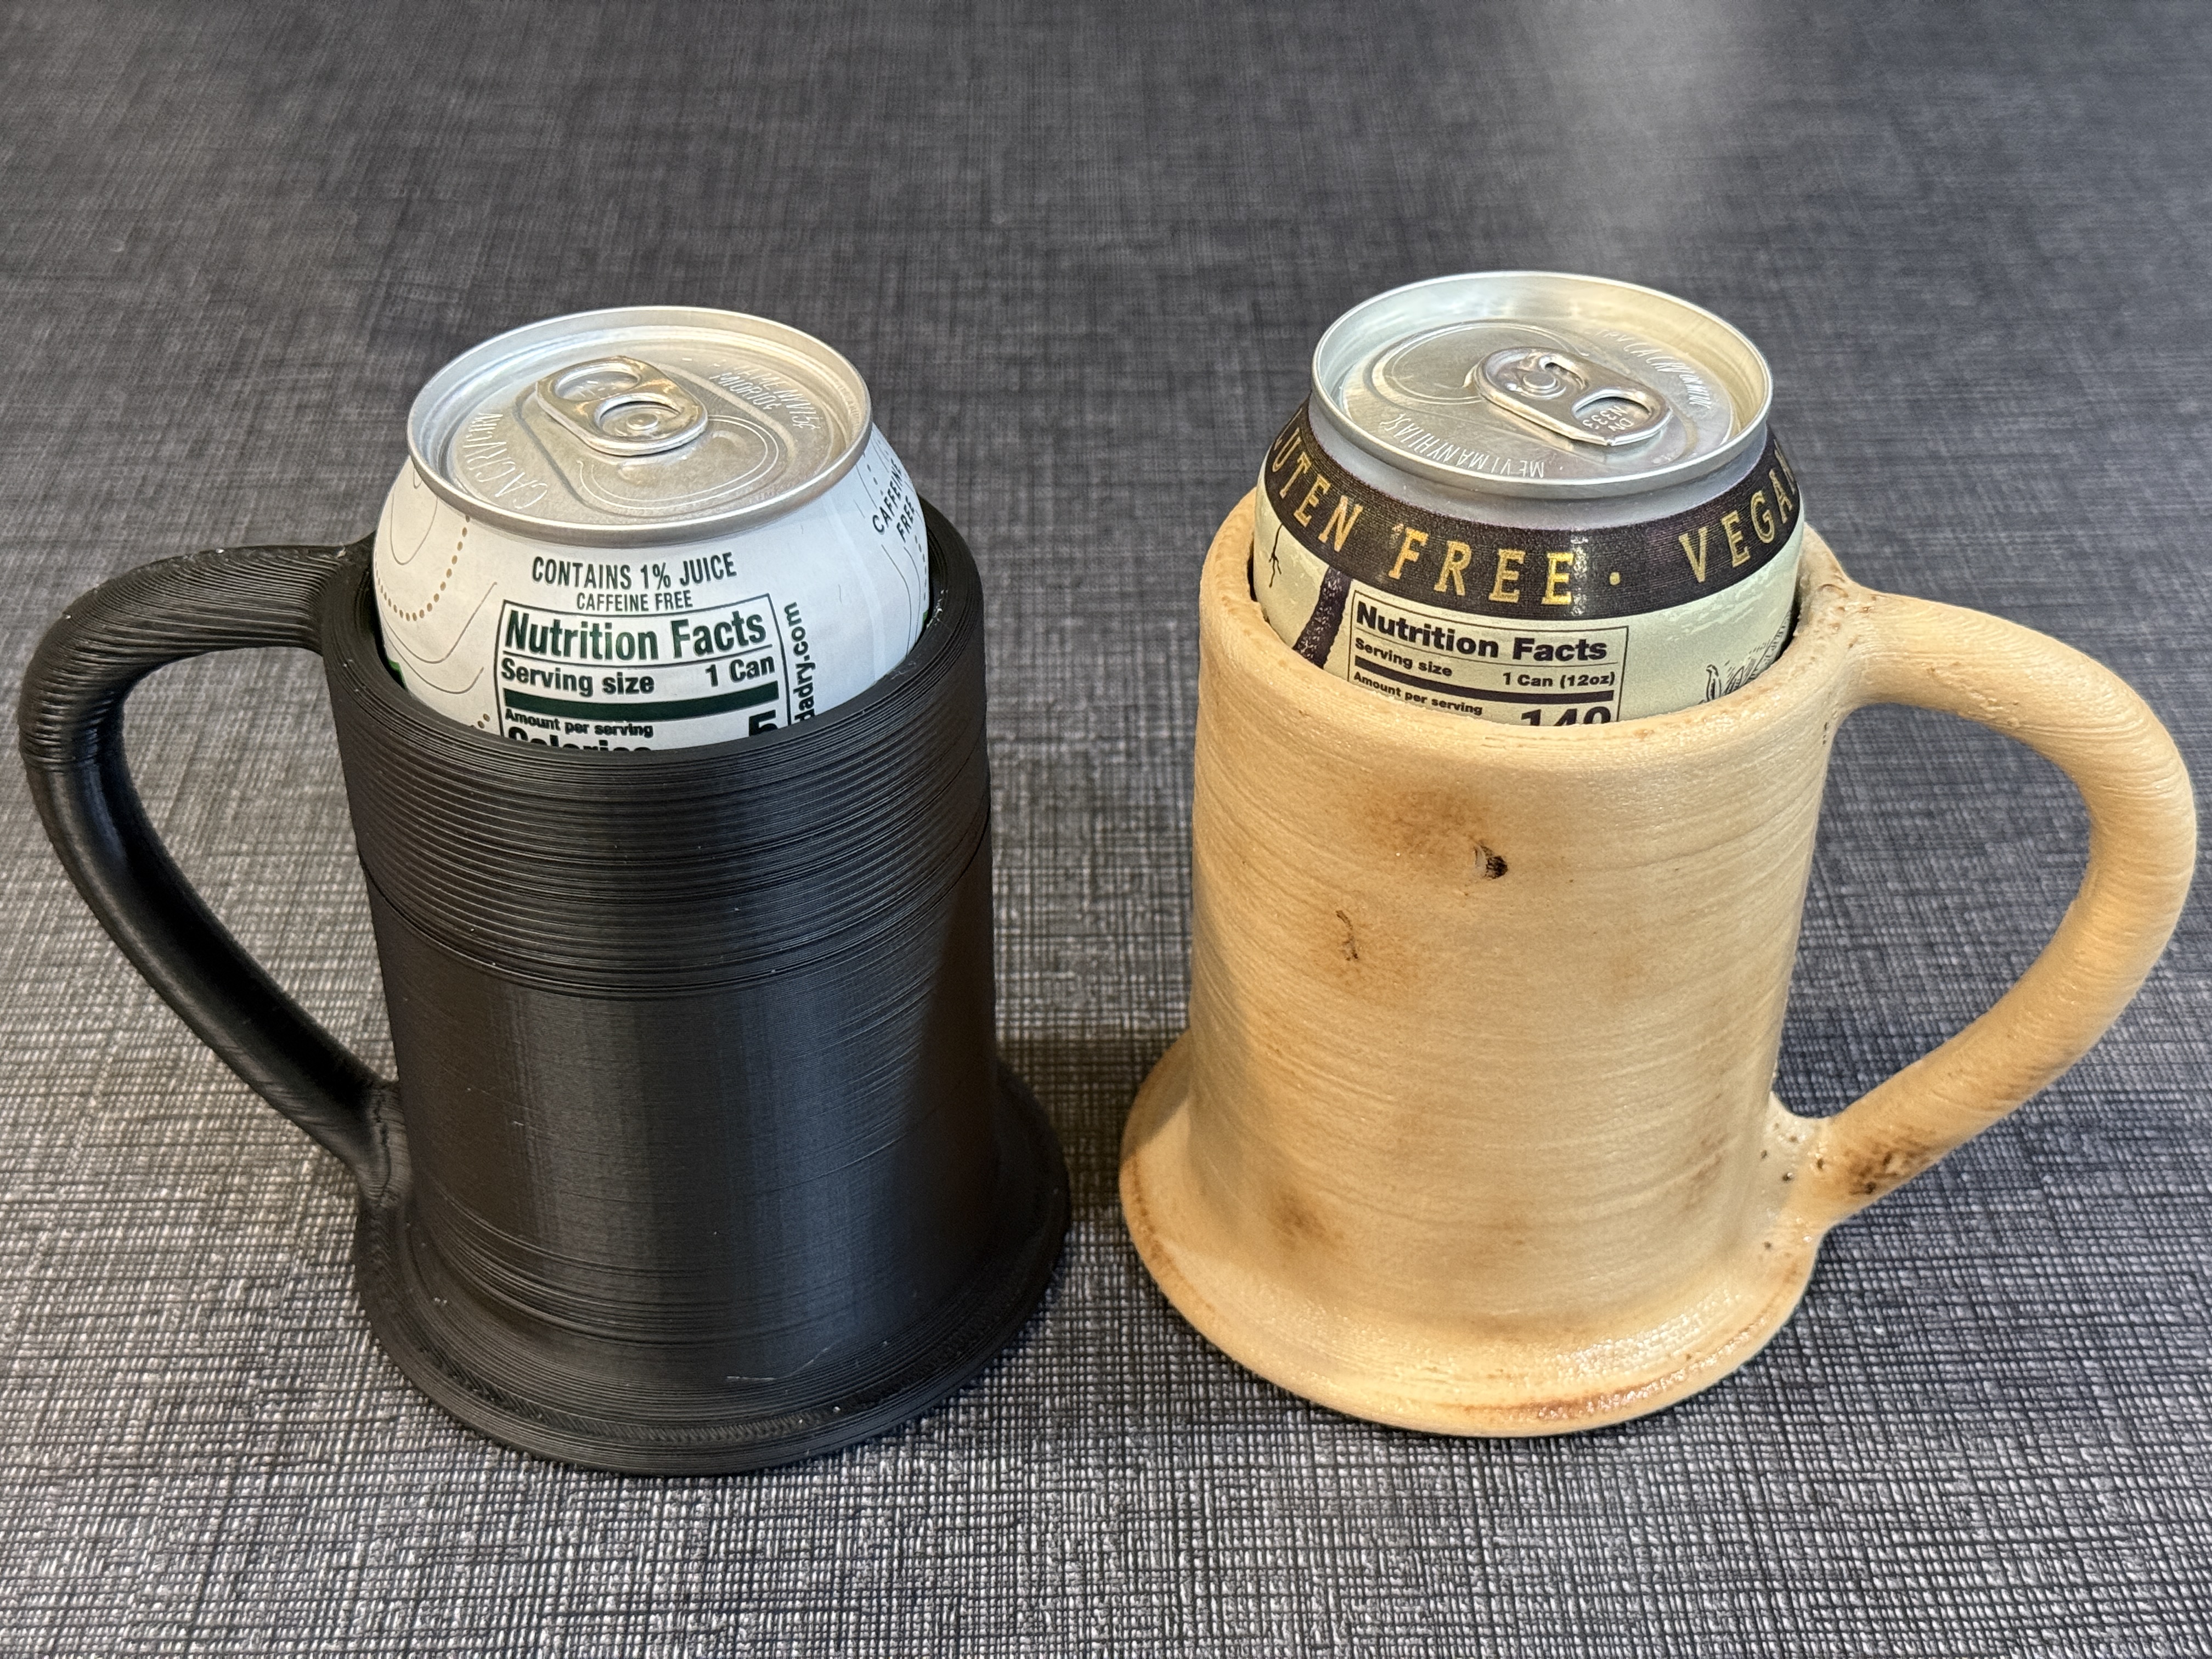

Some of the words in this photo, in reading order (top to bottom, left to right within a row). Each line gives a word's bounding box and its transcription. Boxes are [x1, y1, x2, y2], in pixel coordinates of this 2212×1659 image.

[462, 441, 516, 483] CRV
[495, 472, 548, 509] CA
[872, 458, 902, 534] CAFFEINE
[896, 495, 915, 543] FREE
[532, 556, 631, 590] CONTAINS
[640, 562, 672, 589] 1%
[680, 552, 737, 586] JUICE
[1389, 528, 1576, 606] FREE
[577, 591, 648, 612] CAFFEINE
[655, 590, 693, 610] FREE
[505, 610, 658, 661] Nutrition
[670, 611, 766, 658] Facts
[1356, 600, 1498, 658] Nutrition
[1513, 637, 1607, 661] Facts
[501, 657, 592, 696] Serving
[602, 672, 654, 695] size
[706, 665, 718, 687] 1
[729, 654, 775, 683] Can
[1355, 637, 1412, 669] Serving
[1418, 659, 1452, 677] size
[1503, 672, 1511, 685] 1
[1517, 674, 1553, 686] Can
[1560, 672, 1615, 689] (12oz)
[1353, 672, 1401, 697] Amount
[1405, 692, 1427, 704] per
[1431, 698, 1483, 716] serving
[505, 709, 561, 731] Amount
[565, 722, 589, 735] per
[594, 723, 654, 738] serving
